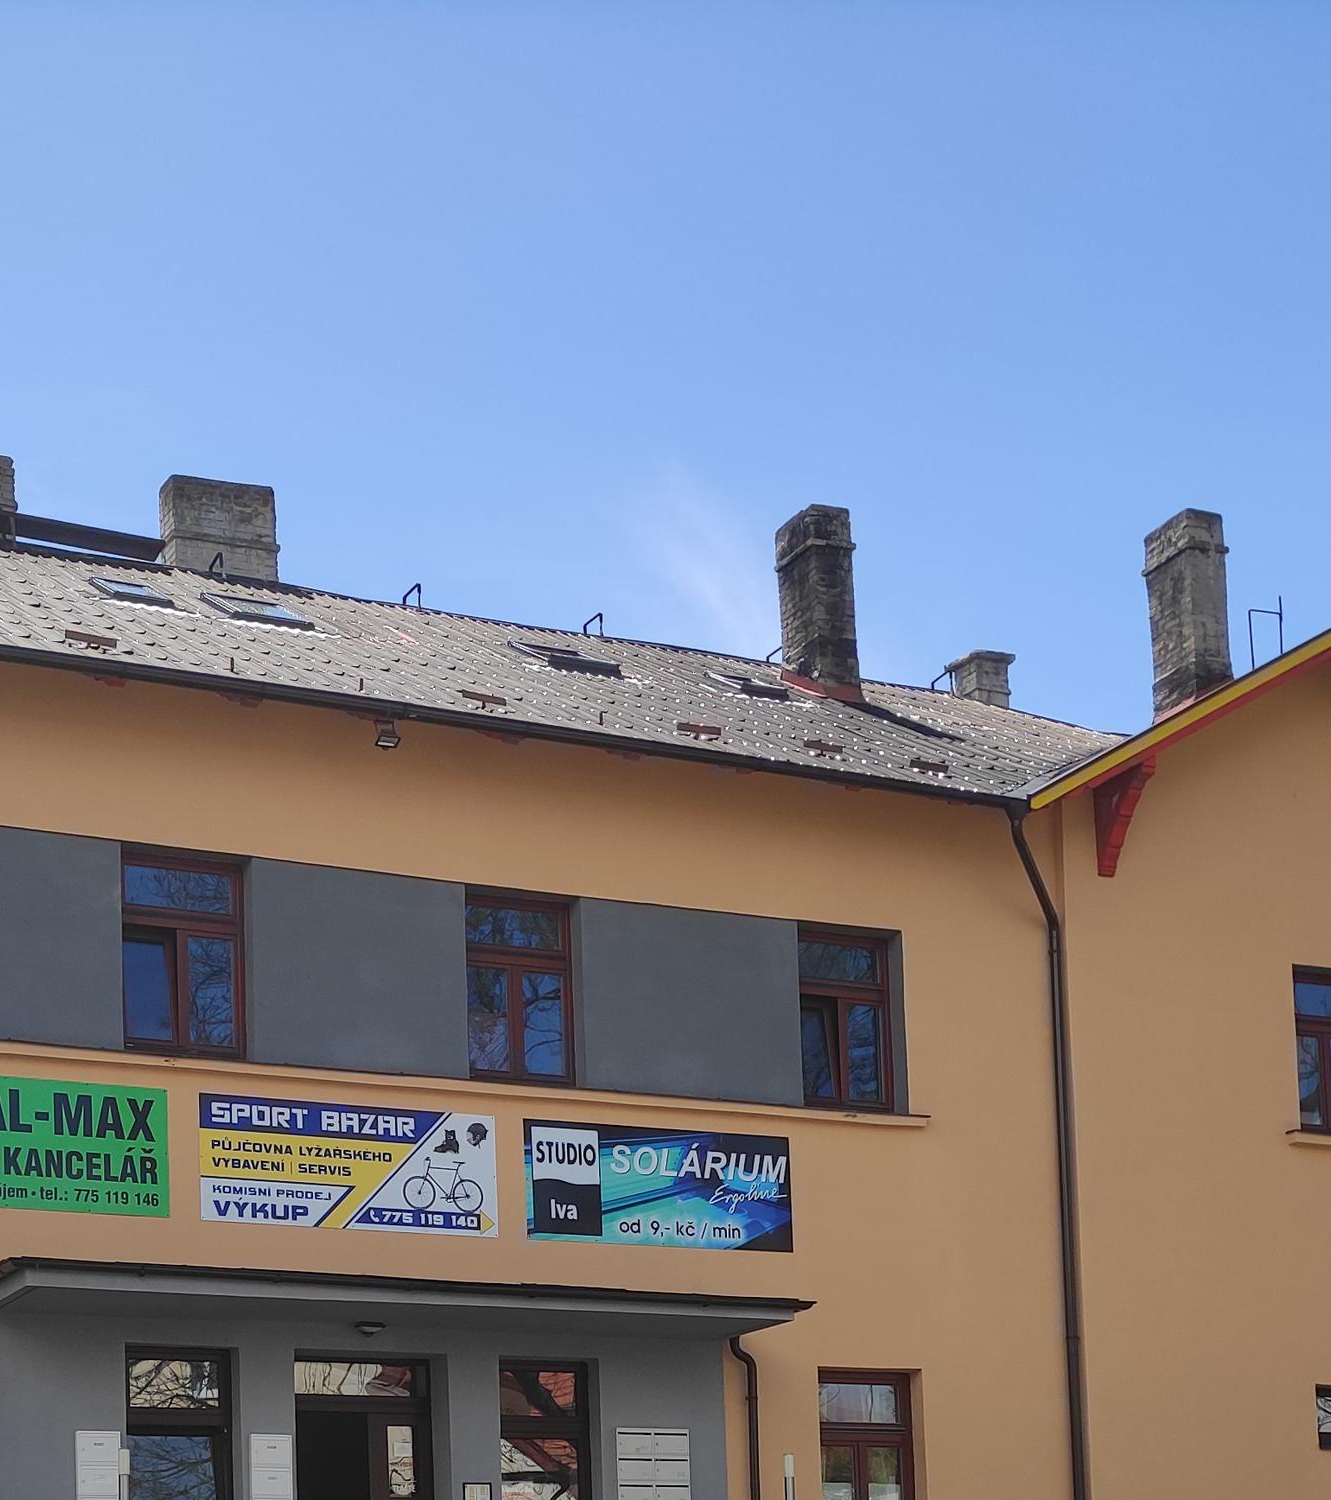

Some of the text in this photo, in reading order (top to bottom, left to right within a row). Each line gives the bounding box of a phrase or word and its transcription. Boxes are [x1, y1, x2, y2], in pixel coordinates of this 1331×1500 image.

[210, 1101, 416, 1138] SPORT BAZAR
[211, 1137, 393, 1163] PŮJČOVNA LYŽAŘSKÉHO
[536, 1140, 596, 1166] STUDIO
[3, 1146, 158, 1185] KANCELÁŘ
[212, 1157, 352, 1177] VYBAVENÍ SERVIS
[610, 1142, 788, 1184] SOLÁRIUM
[40, 1186, 69, 1201] tel.:
[74, 1188, 100, 1203] 775
[105, 1190, 129, 1205] 119
[134, 1192, 159, 1207] 146
[276, 1189, 332, 1201] PRODEJ
[709, 1182, 788, 1215] Ergoline
[213, 1197, 309, 1222] VÝKUP
[381, 1211, 478, 1228] 775 119 140
[549, 1198, 579, 1220] Iva
[619, 1219, 641, 1234] od
[712, 1224, 742, 1240] min
